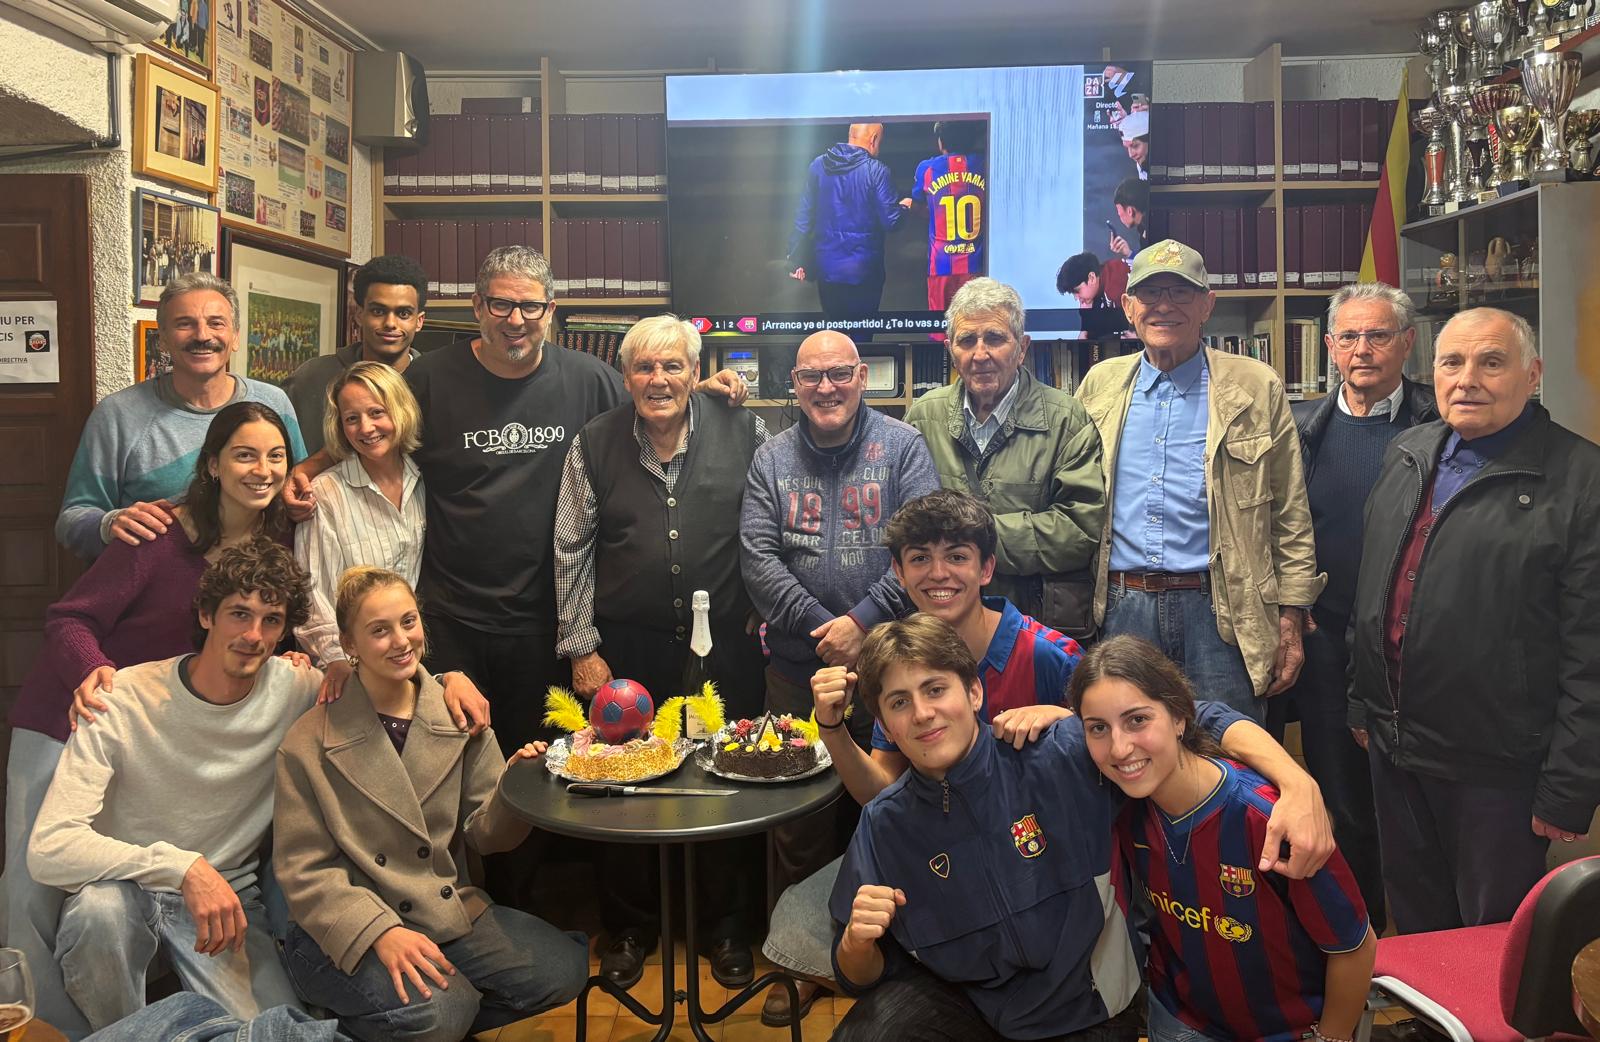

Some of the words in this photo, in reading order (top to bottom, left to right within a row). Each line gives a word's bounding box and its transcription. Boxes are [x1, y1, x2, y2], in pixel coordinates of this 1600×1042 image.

[927, 172, 960, 195] LAMINE
[939, 194, 981, 241] 10
[15, 316, 35, 325] PER
[715, 320, 720, 329] 1
[728, 320, 734, 329] 2
[762, 320, 801, 331] ¡Arranca
[803, 321, 814, 331] ya
[816, 320, 825, 329] el
[826, 319, 884, 331] postpartido!
[886, 319, 902, 330] ¿Te
[904, 319, 914, 328] lo
[916, 320, 931, 328] vas
[463, 429, 502, 449] FCB
[527, 425, 565, 444] 1899
[787, 491, 822, 534] 18
[842, 482, 882, 529] 99
[841, 551, 864, 567] NOU
[1141, 879, 1211, 933] unicef
